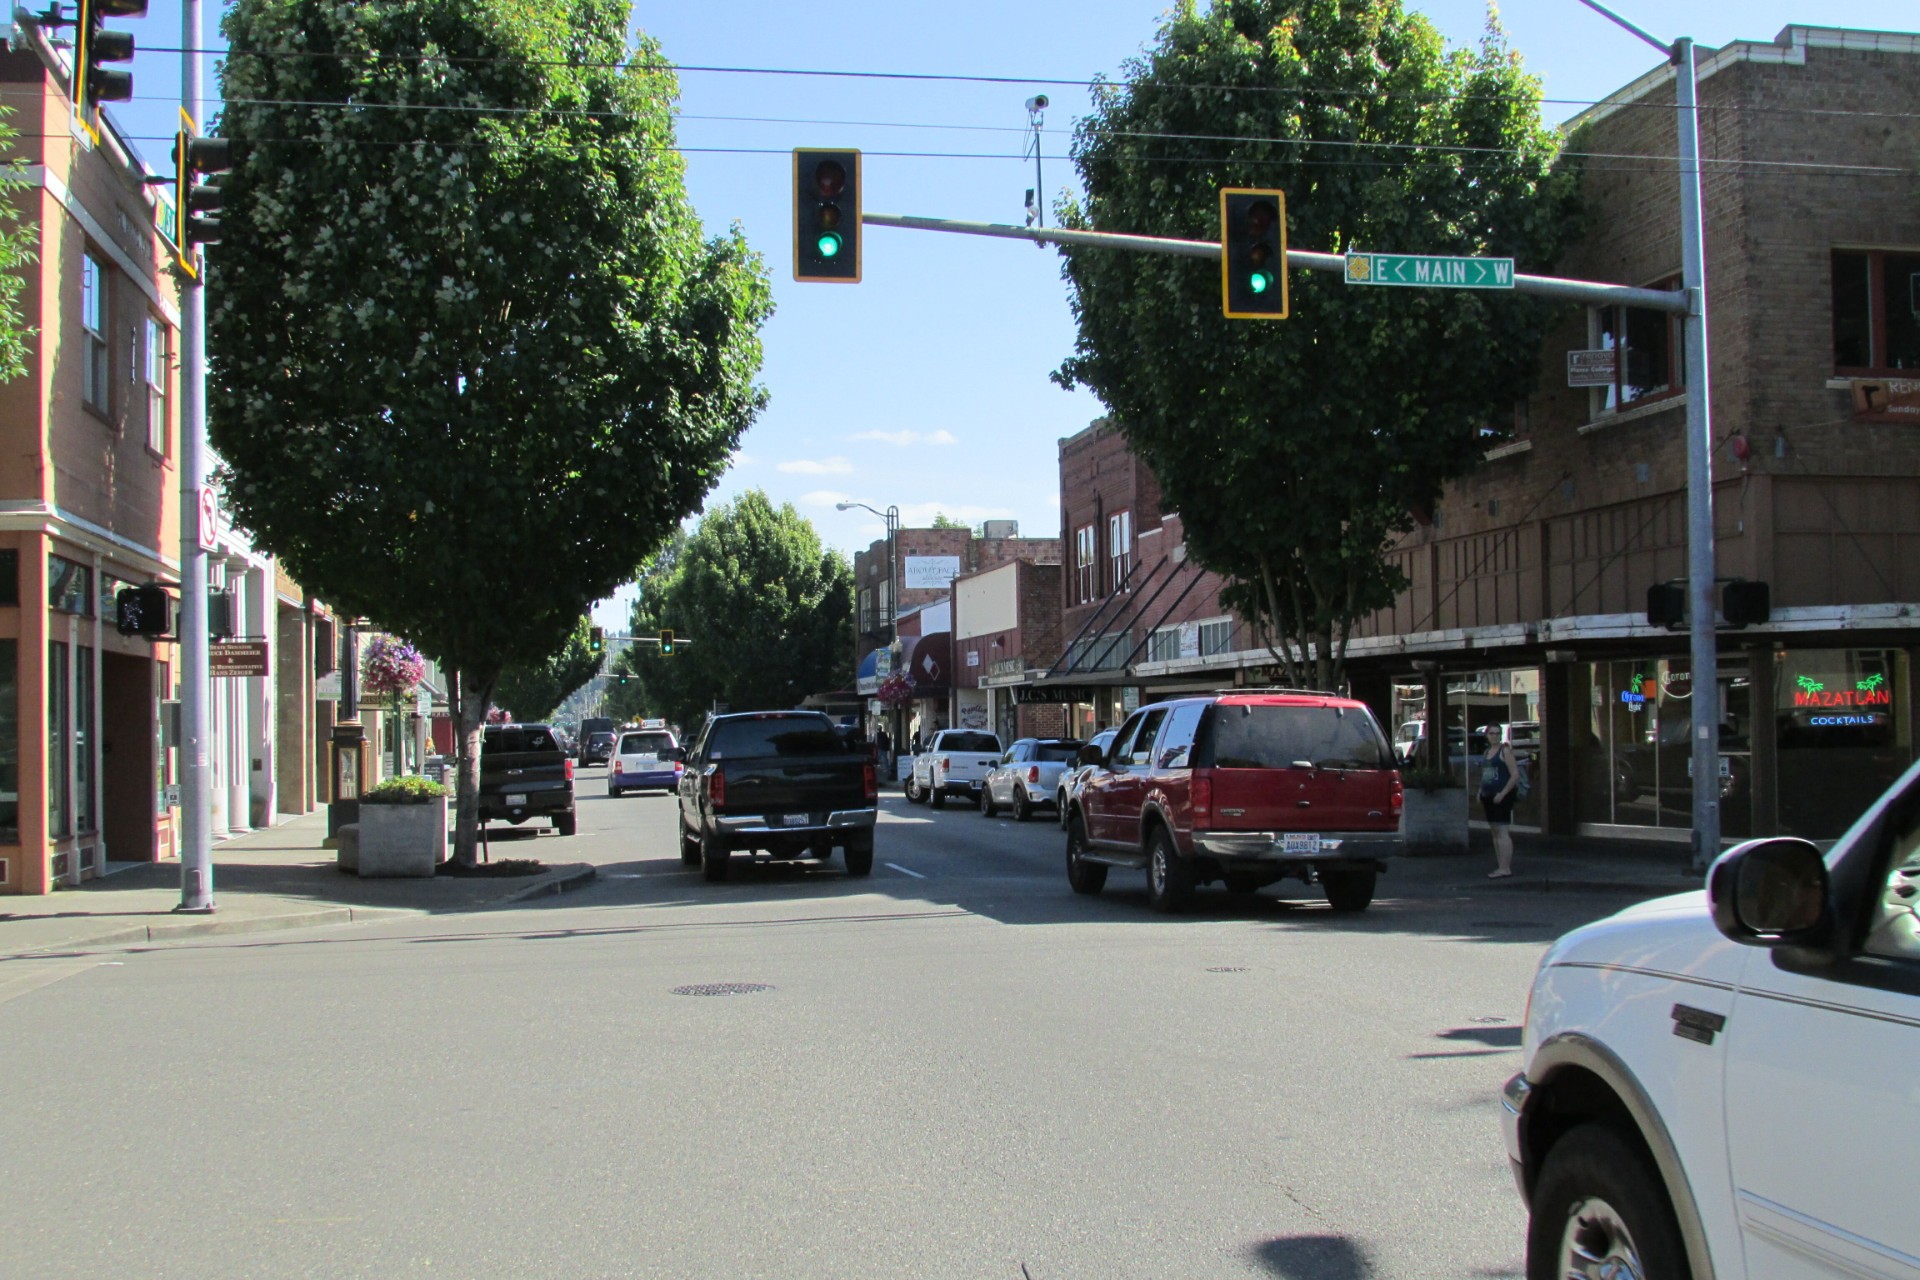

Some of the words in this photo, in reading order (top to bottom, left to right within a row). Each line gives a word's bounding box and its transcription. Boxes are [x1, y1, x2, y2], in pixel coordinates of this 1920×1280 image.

[1377, 258, 1388, 281] E
[1415, 260, 1465, 283] MAIN
[1493, 262, 1509, 284] W
[1054, 688, 1088, 699] MUSIC
[1794, 690, 1890, 707] MAZATLAN
[1810, 715, 1874, 726] COCKTAILS
